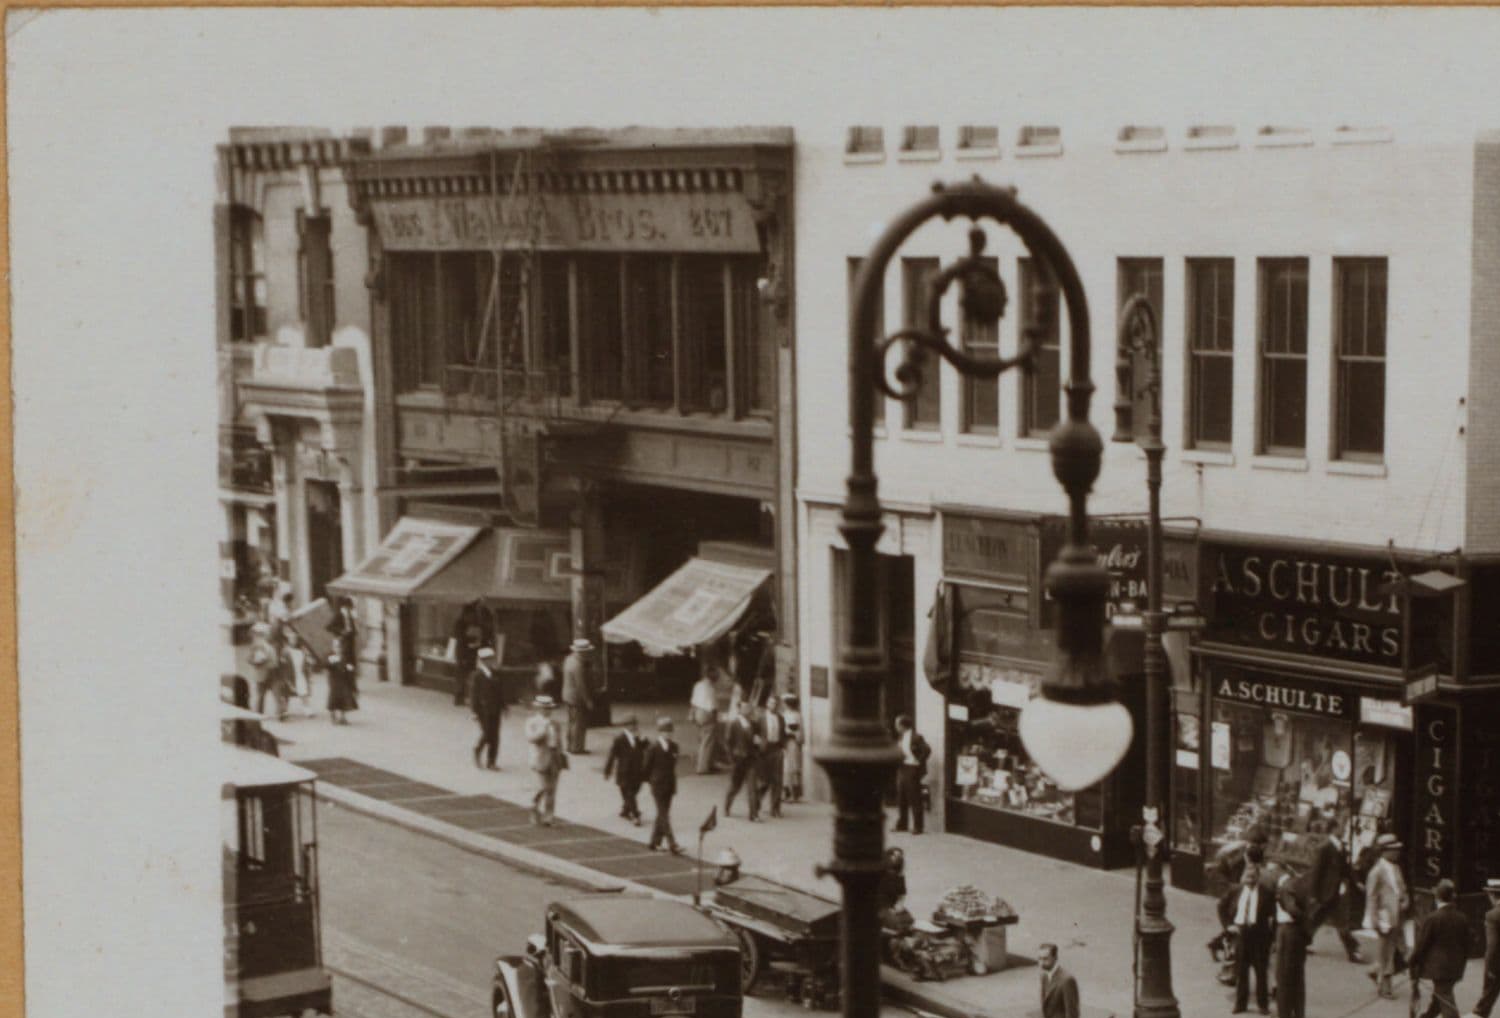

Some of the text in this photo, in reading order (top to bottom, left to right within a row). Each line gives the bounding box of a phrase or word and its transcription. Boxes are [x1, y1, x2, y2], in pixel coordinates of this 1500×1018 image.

[572, 195, 667, 242] Bros.
[1259, 611, 1401, 657] CIGARS
[1424, 718, 1447, 878] CIGARS
